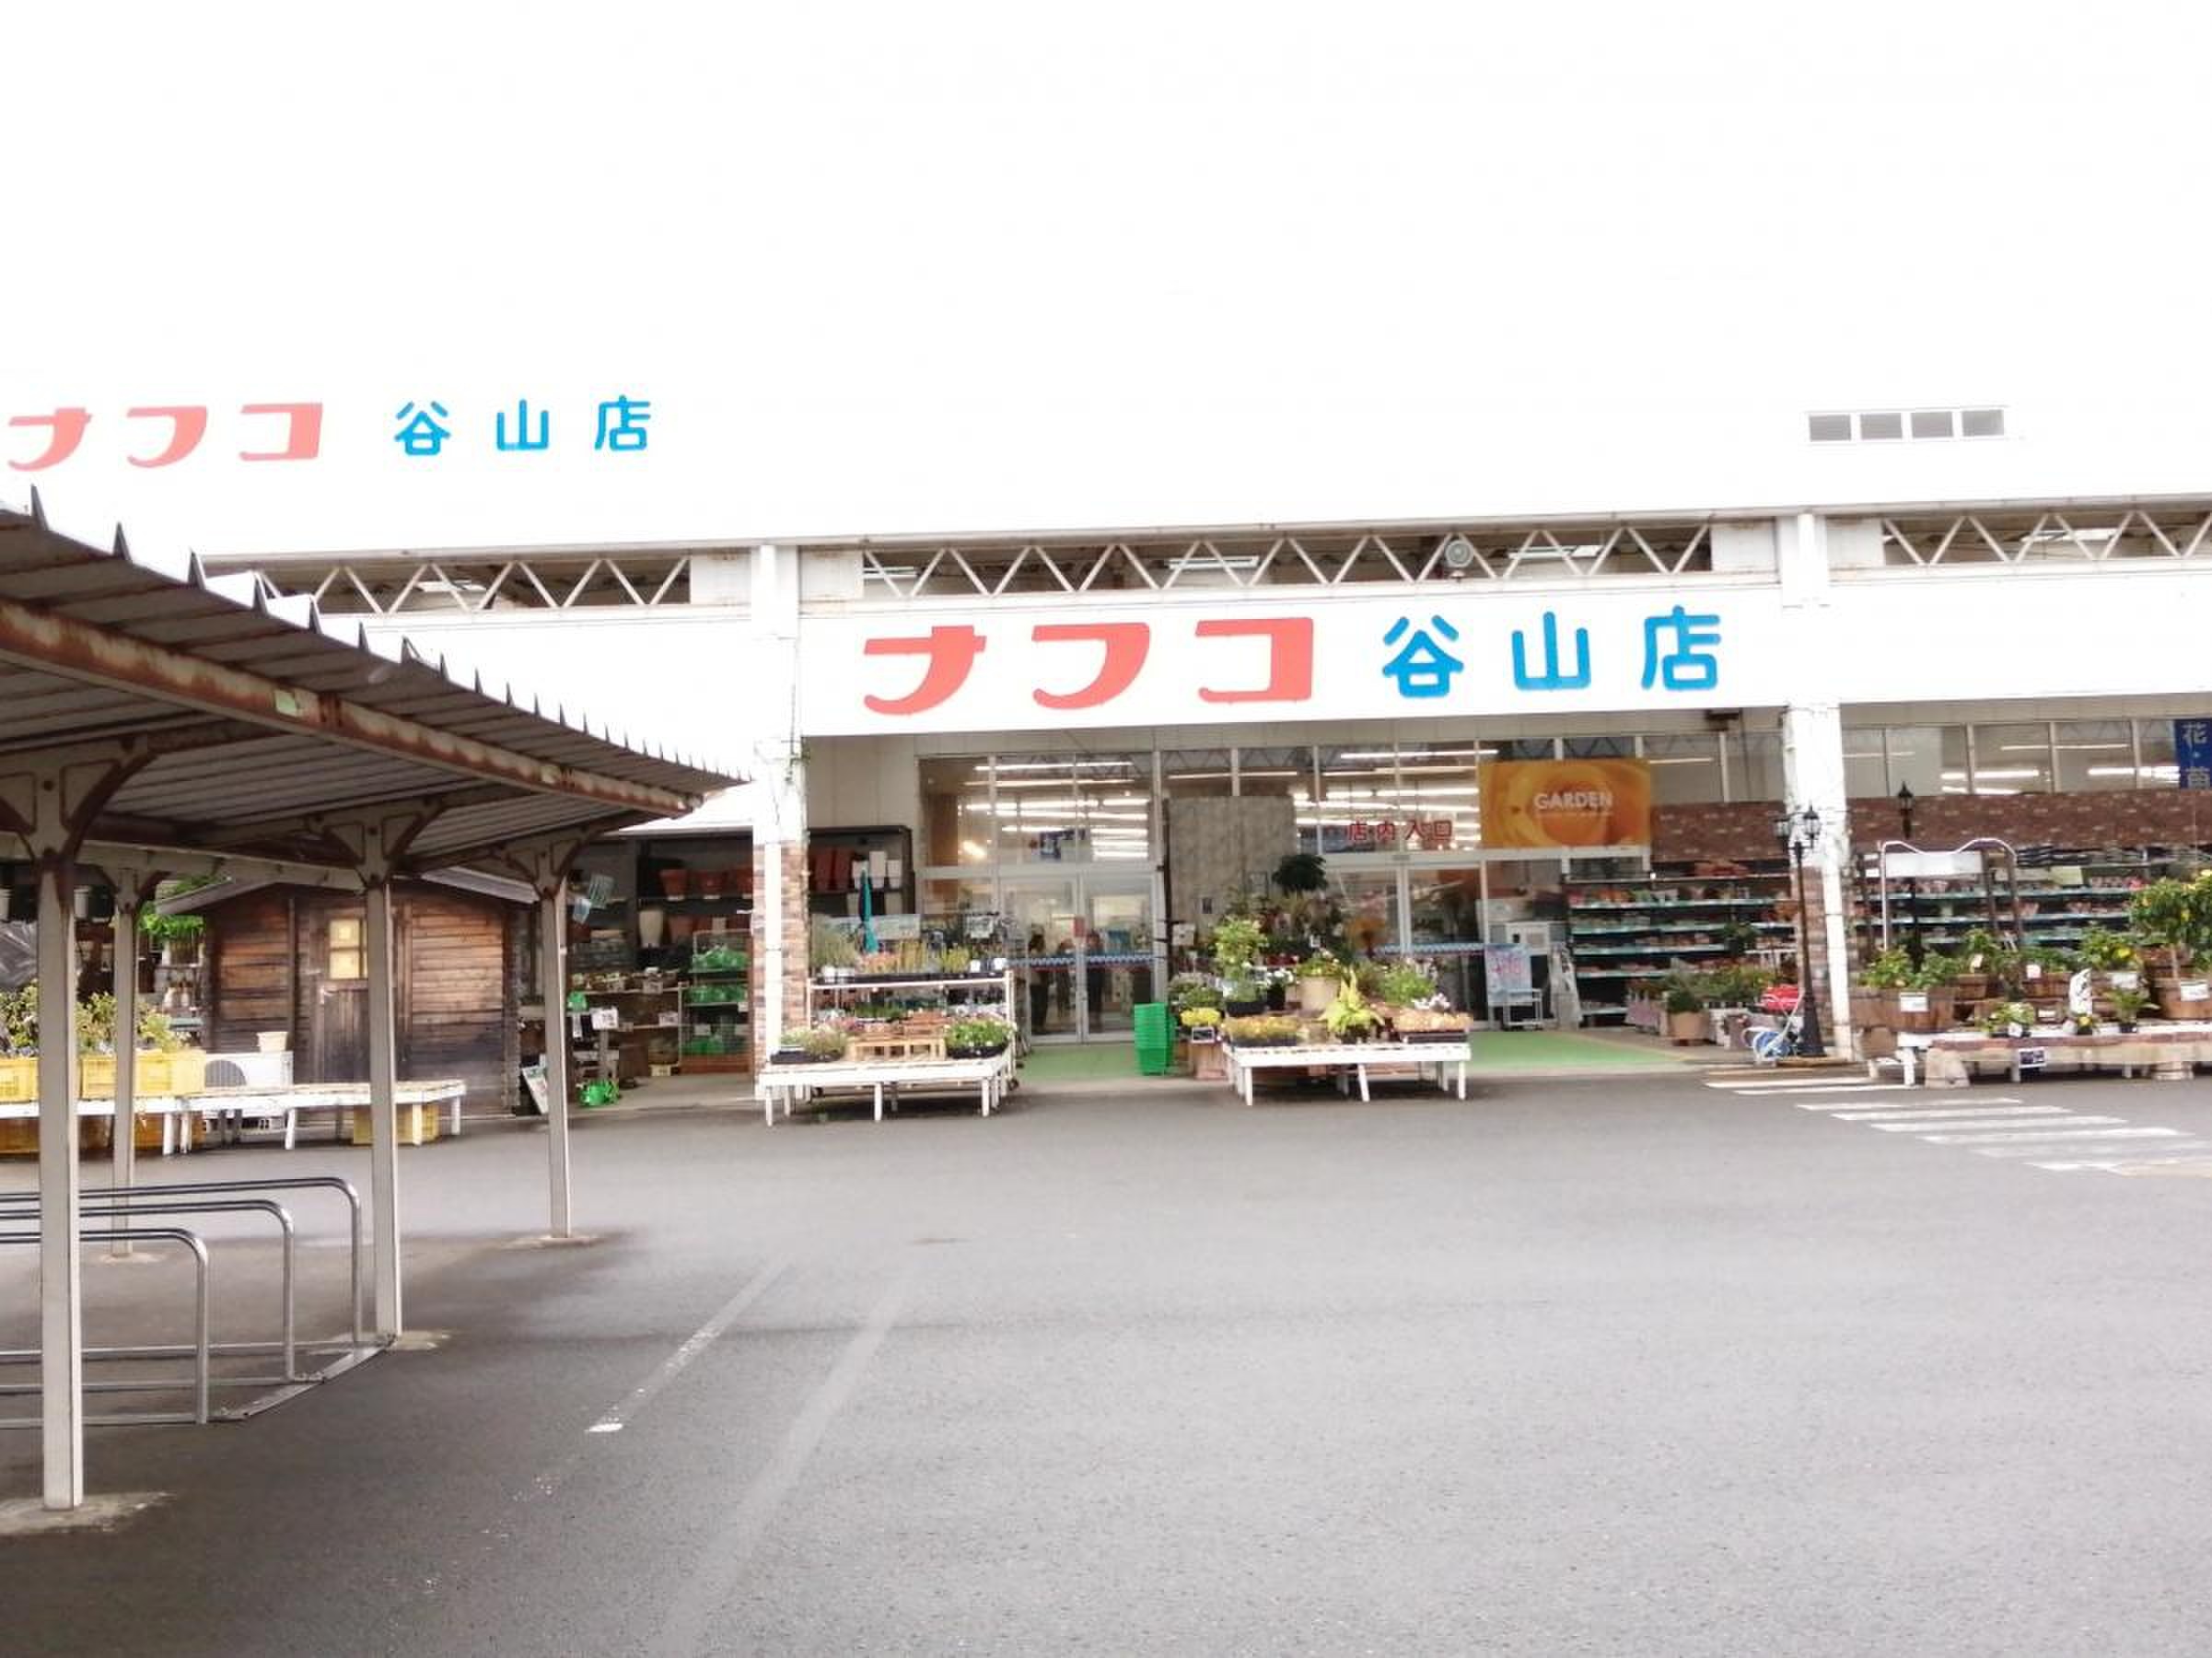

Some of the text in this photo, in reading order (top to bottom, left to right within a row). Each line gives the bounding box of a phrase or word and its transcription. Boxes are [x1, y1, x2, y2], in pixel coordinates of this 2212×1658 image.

[8, 394, 651, 472] ナフコ 谷山店
[864, 604, 1722, 716] ナフコ 谷山店
[1533, 791, 1613, 811] GARDEN
